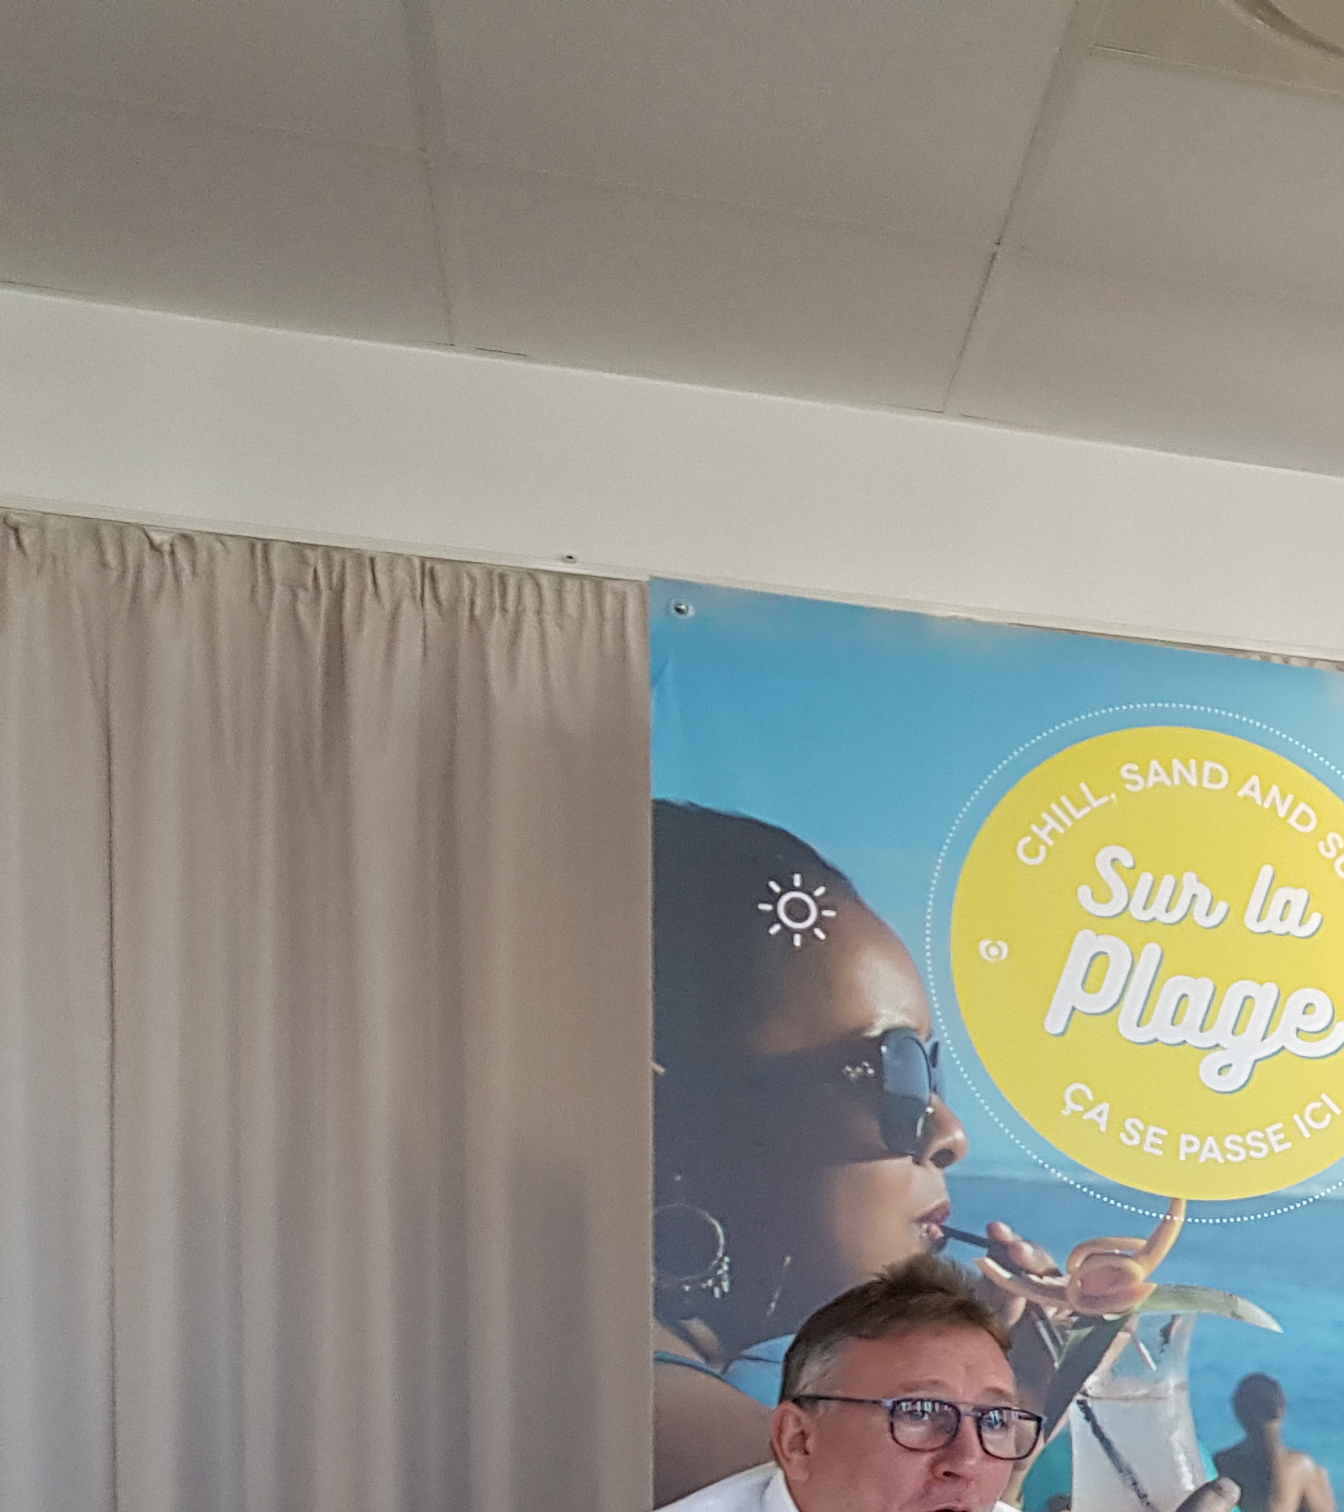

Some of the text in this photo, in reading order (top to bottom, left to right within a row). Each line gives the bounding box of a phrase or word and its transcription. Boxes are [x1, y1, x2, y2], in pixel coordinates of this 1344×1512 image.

[1016, 782, 1117, 865] CHILL,
[1120, 759, 1229, 792] SAND
[1237, 775, 1318, 833] AND
[1077, 845, 1323, 938] Sur la
[1061, 1082, 1342, 1163] ÇA SE PASSE ICI
